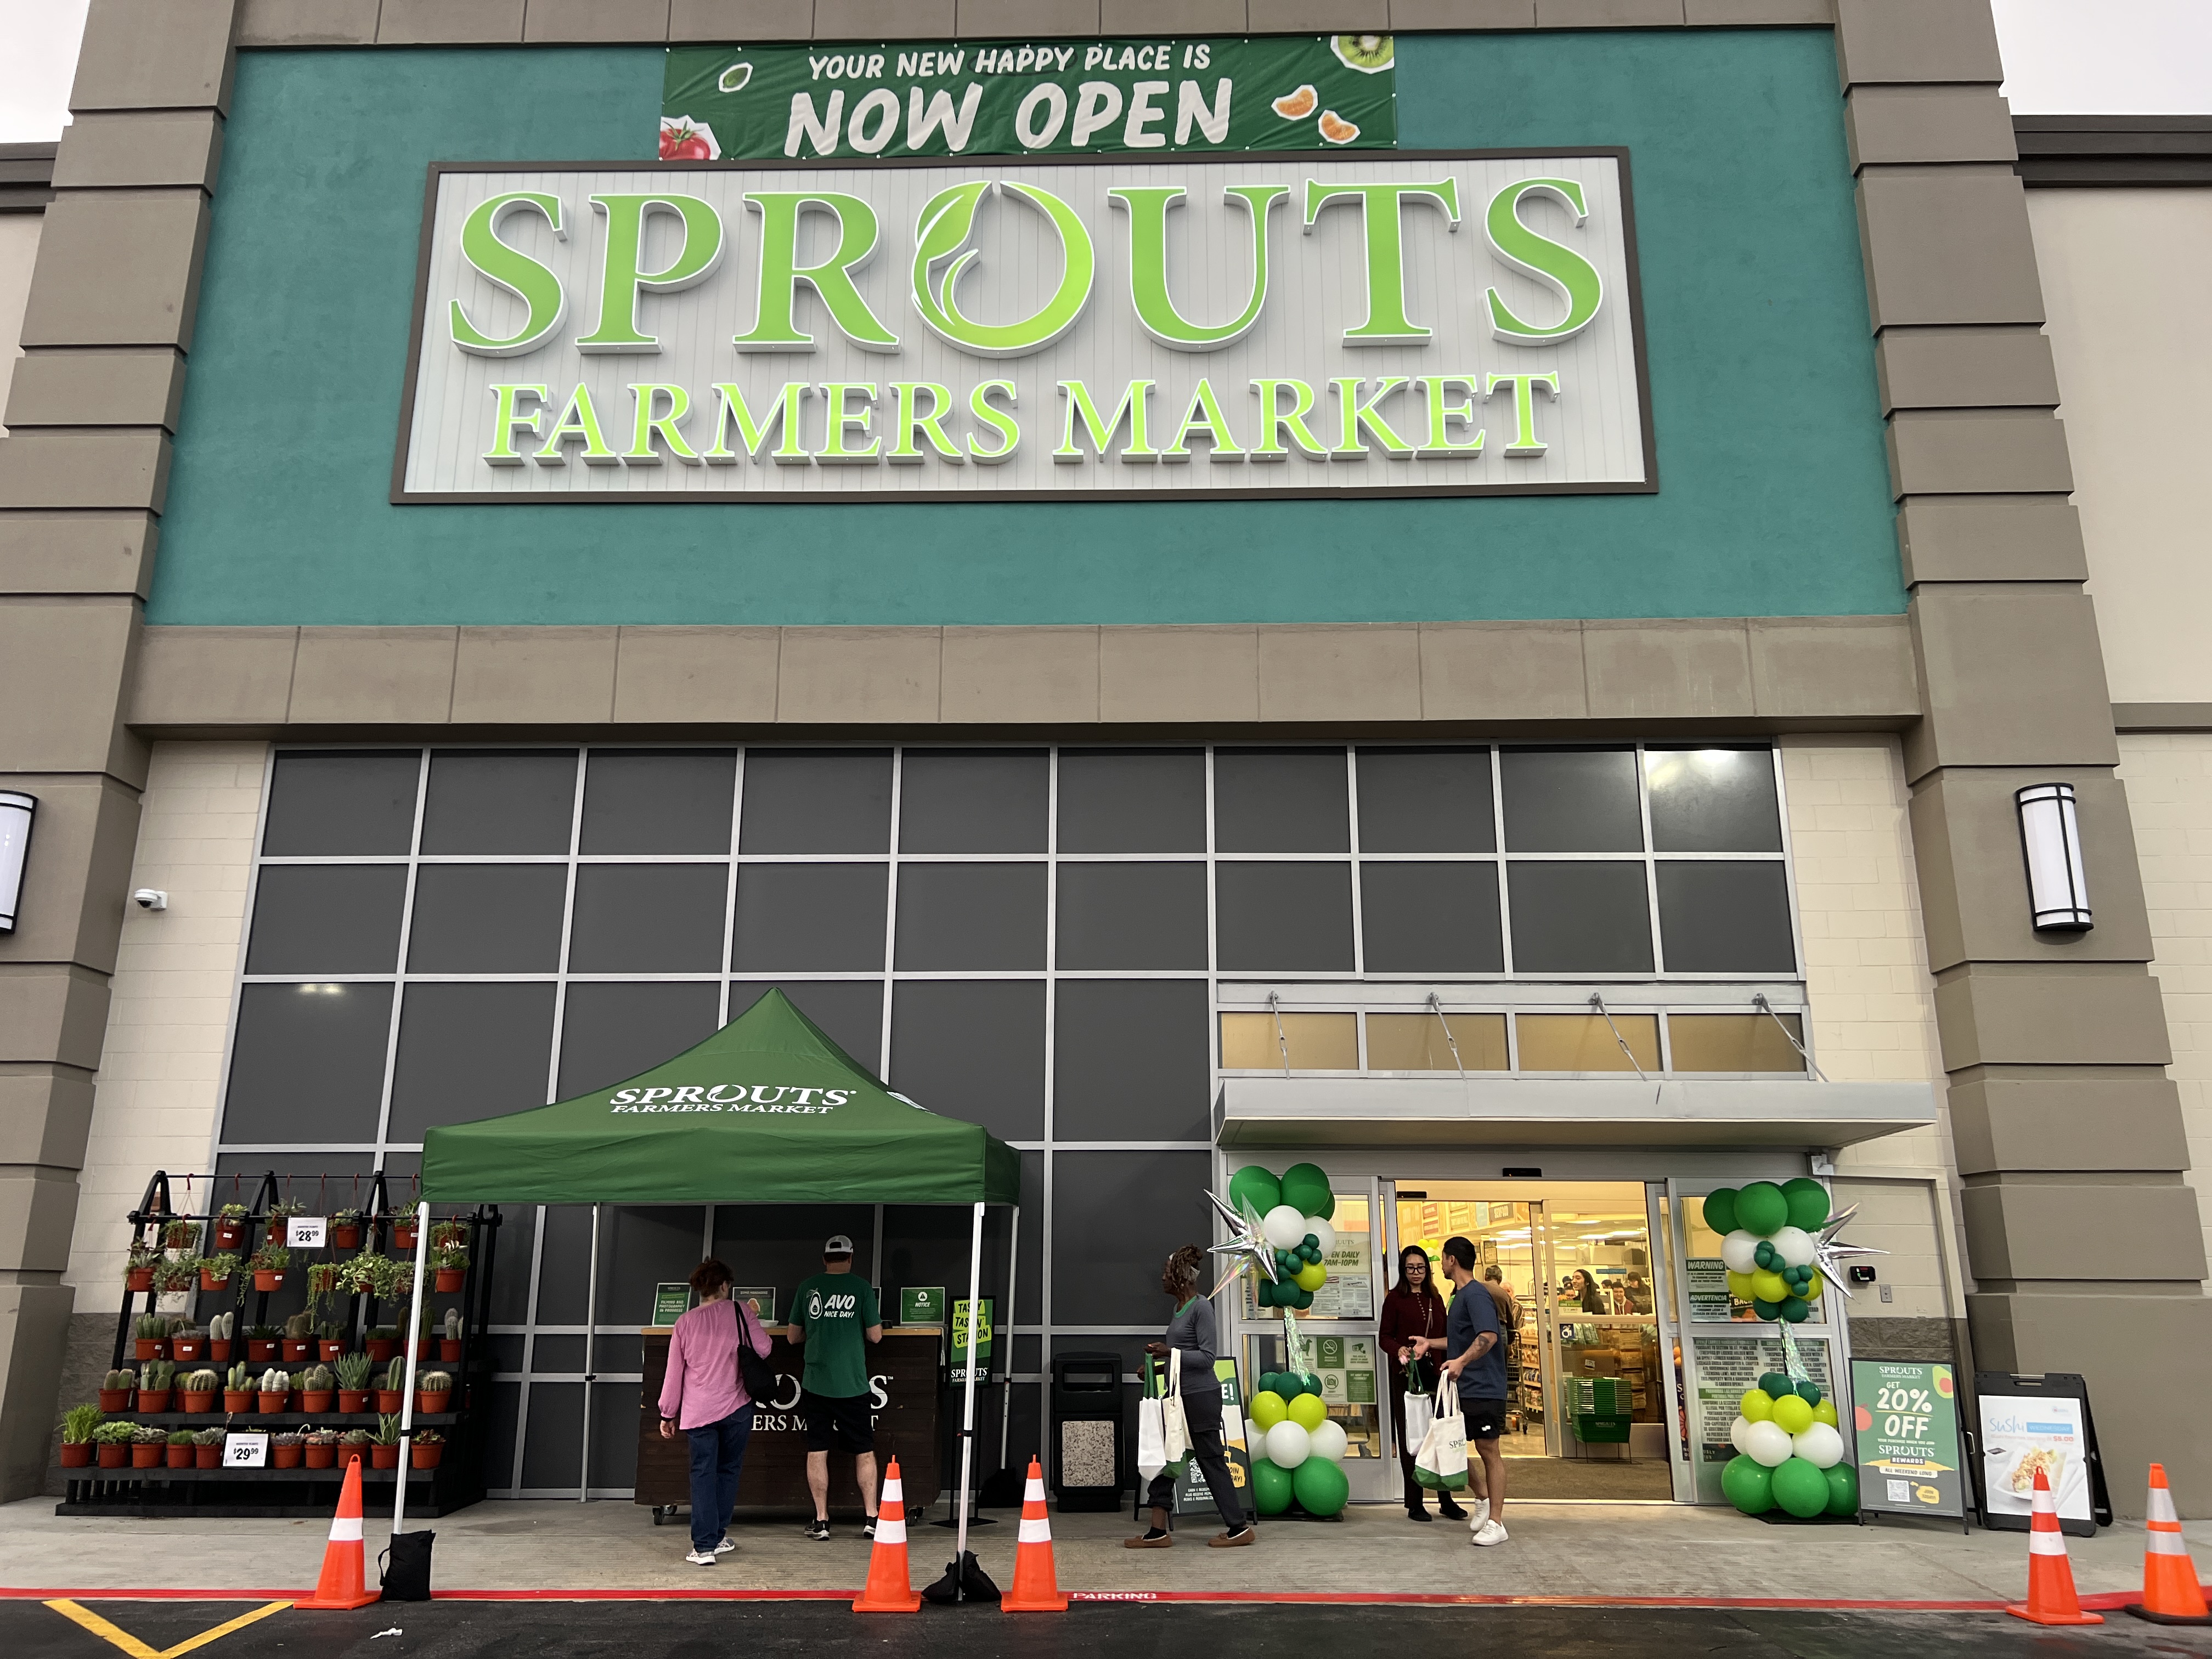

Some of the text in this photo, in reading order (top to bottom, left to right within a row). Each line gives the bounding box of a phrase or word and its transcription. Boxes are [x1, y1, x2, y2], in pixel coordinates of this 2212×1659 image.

[809, 44, 1210, 80] YOUR NEW HAPPY PLACE IS
[784, 77, 1232, 157] NOW OPEN
[450, 179, 1604, 359] SPROUTS
[483, 371, 1561, 467] FARMERS MARKET
[610, 1084, 849, 1106] SPROUTS
[611, 1103, 833, 1114] FARMERS MARKET
[1688, 1261, 1724, 1269] WARNING
[824, 1294, 855, 1310] AVO
[958, 1301, 982, 1313] TAY
[957, 1328, 988, 1344] STAON
[951, 1368, 988, 1378] SPRUTS
[1879, 1366, 1923, 1375] SPROUTS
[1877, 1387, 1932, 1413] 20%
[1884, 1414, 1929, 1439] OFF
[1449, 1438, 1466, 1449] SPRO
[1878, 1444, 1934, 1457] SPROUTS
